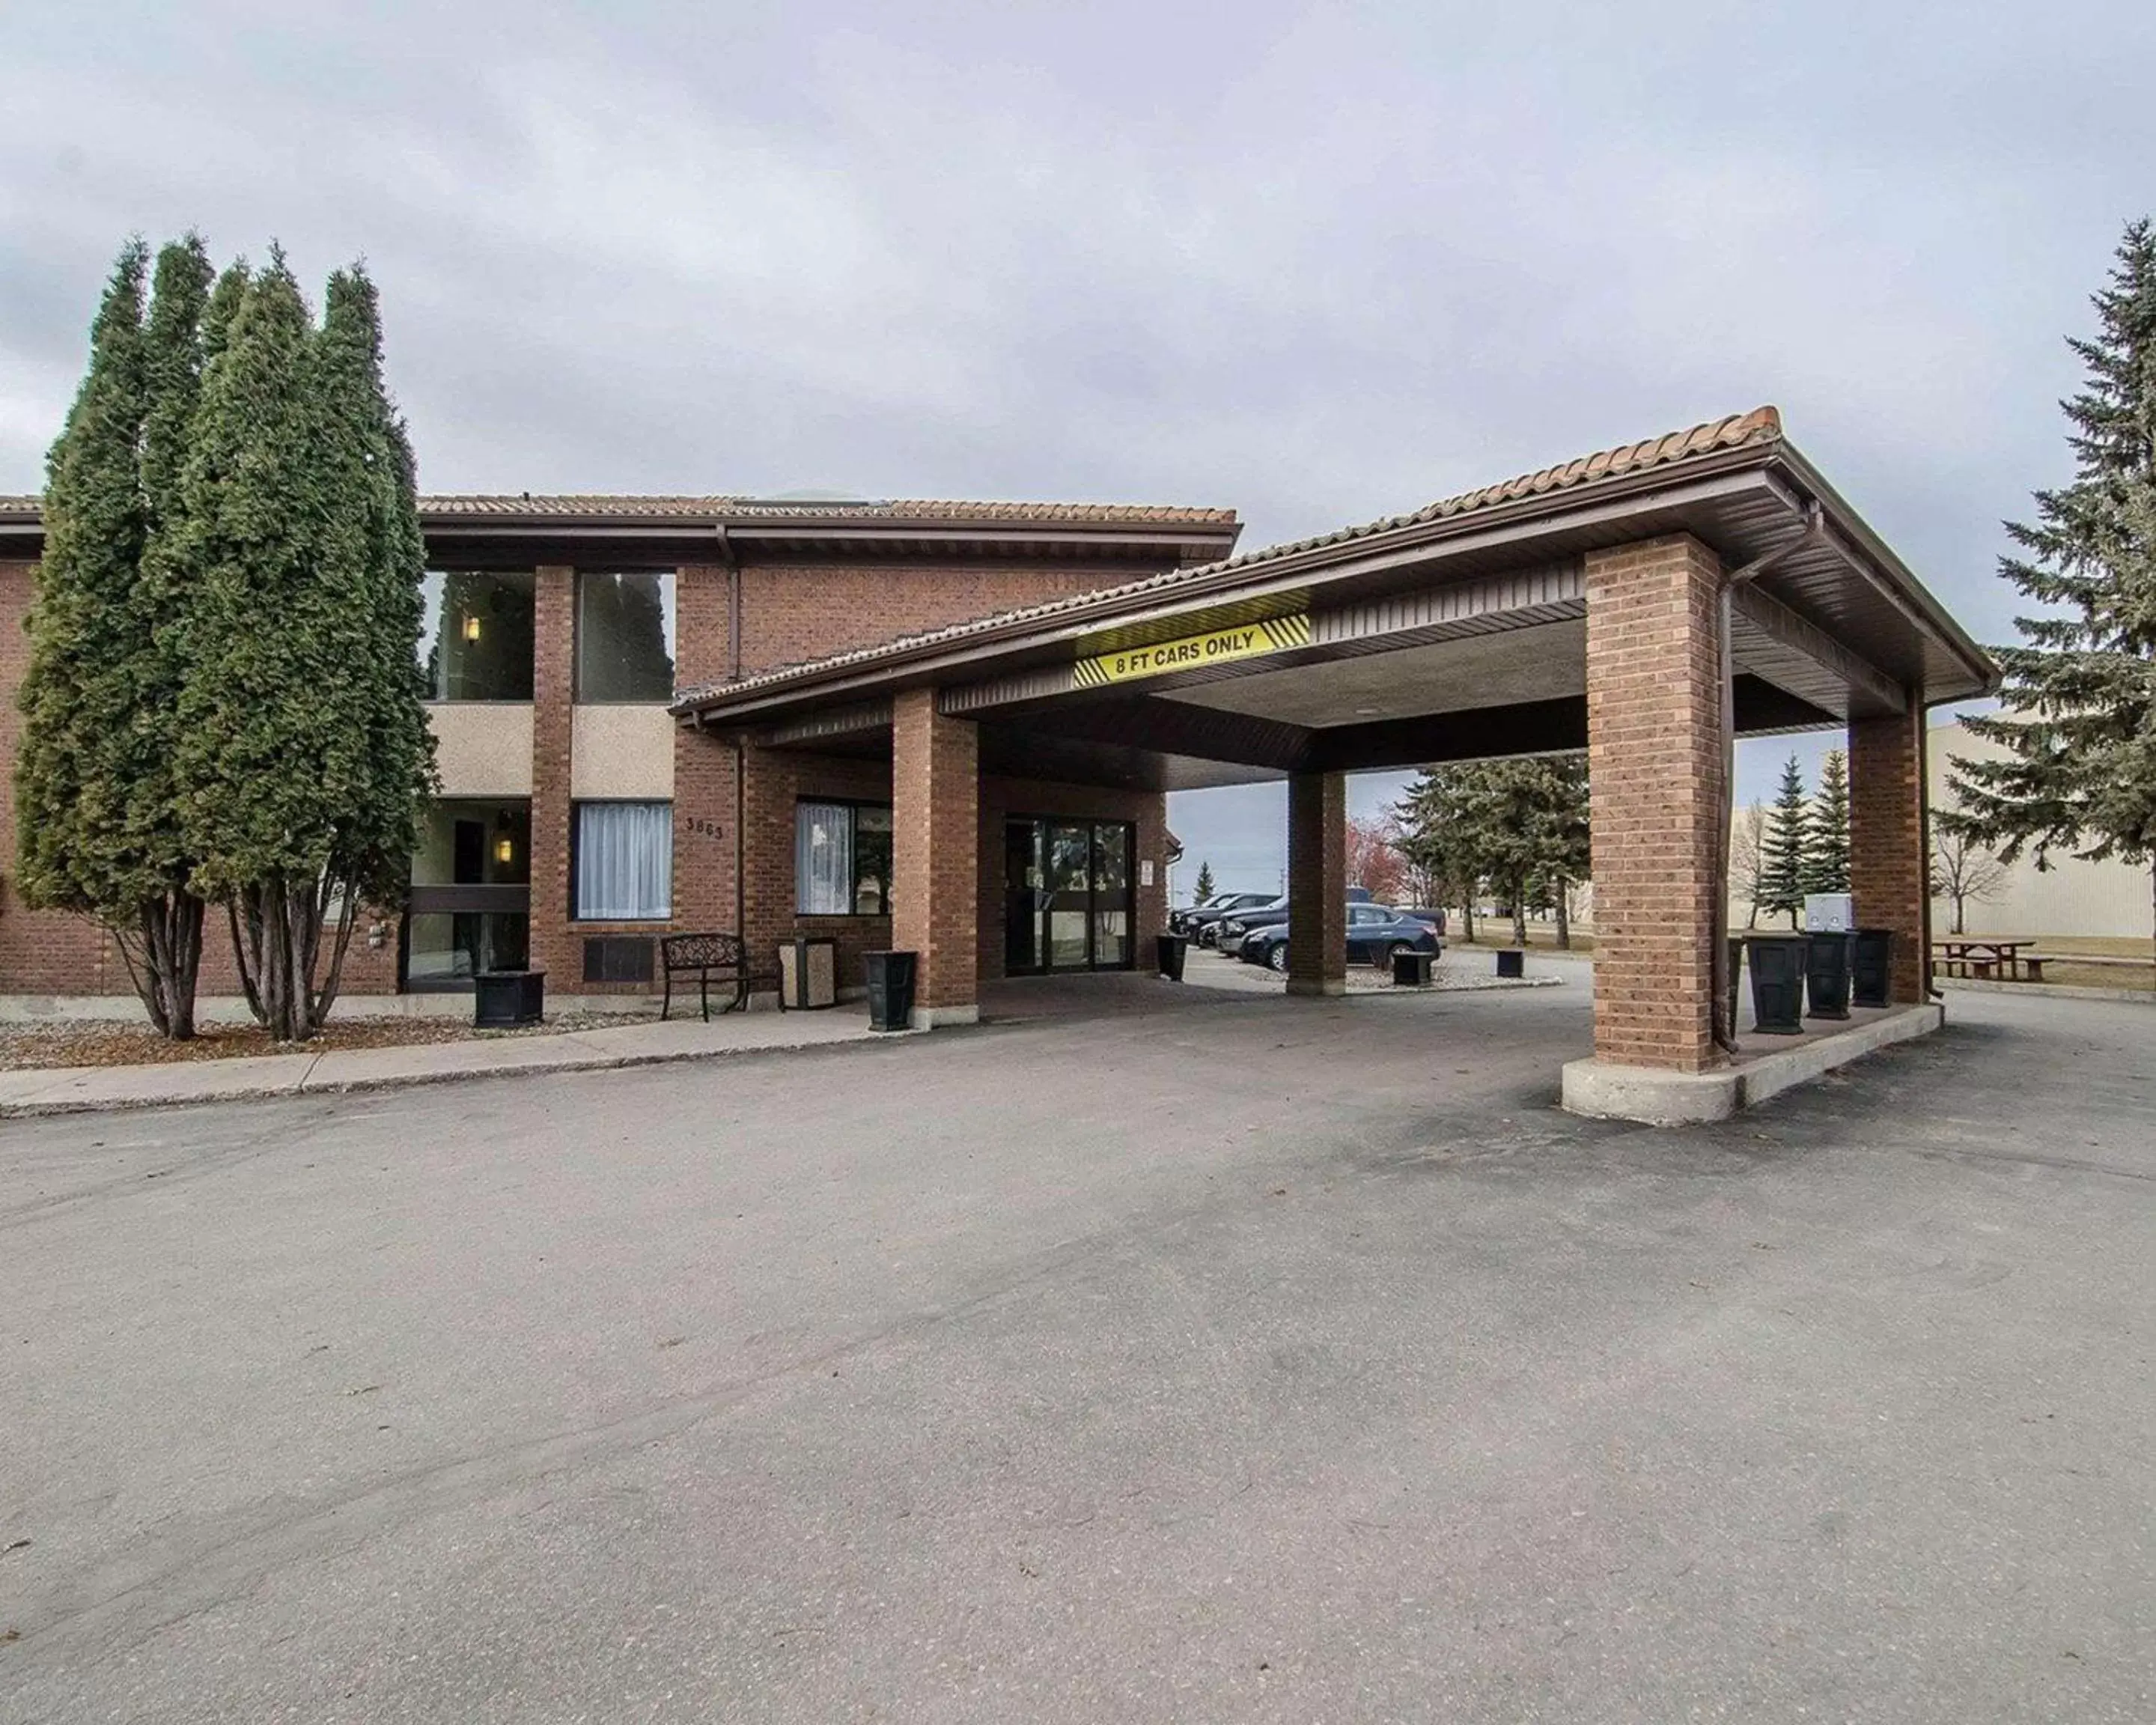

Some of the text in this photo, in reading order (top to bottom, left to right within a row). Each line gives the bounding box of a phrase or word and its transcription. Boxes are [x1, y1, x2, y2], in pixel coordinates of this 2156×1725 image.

[1116, 631, 1255, 674] 8 FT CARS ONLY
